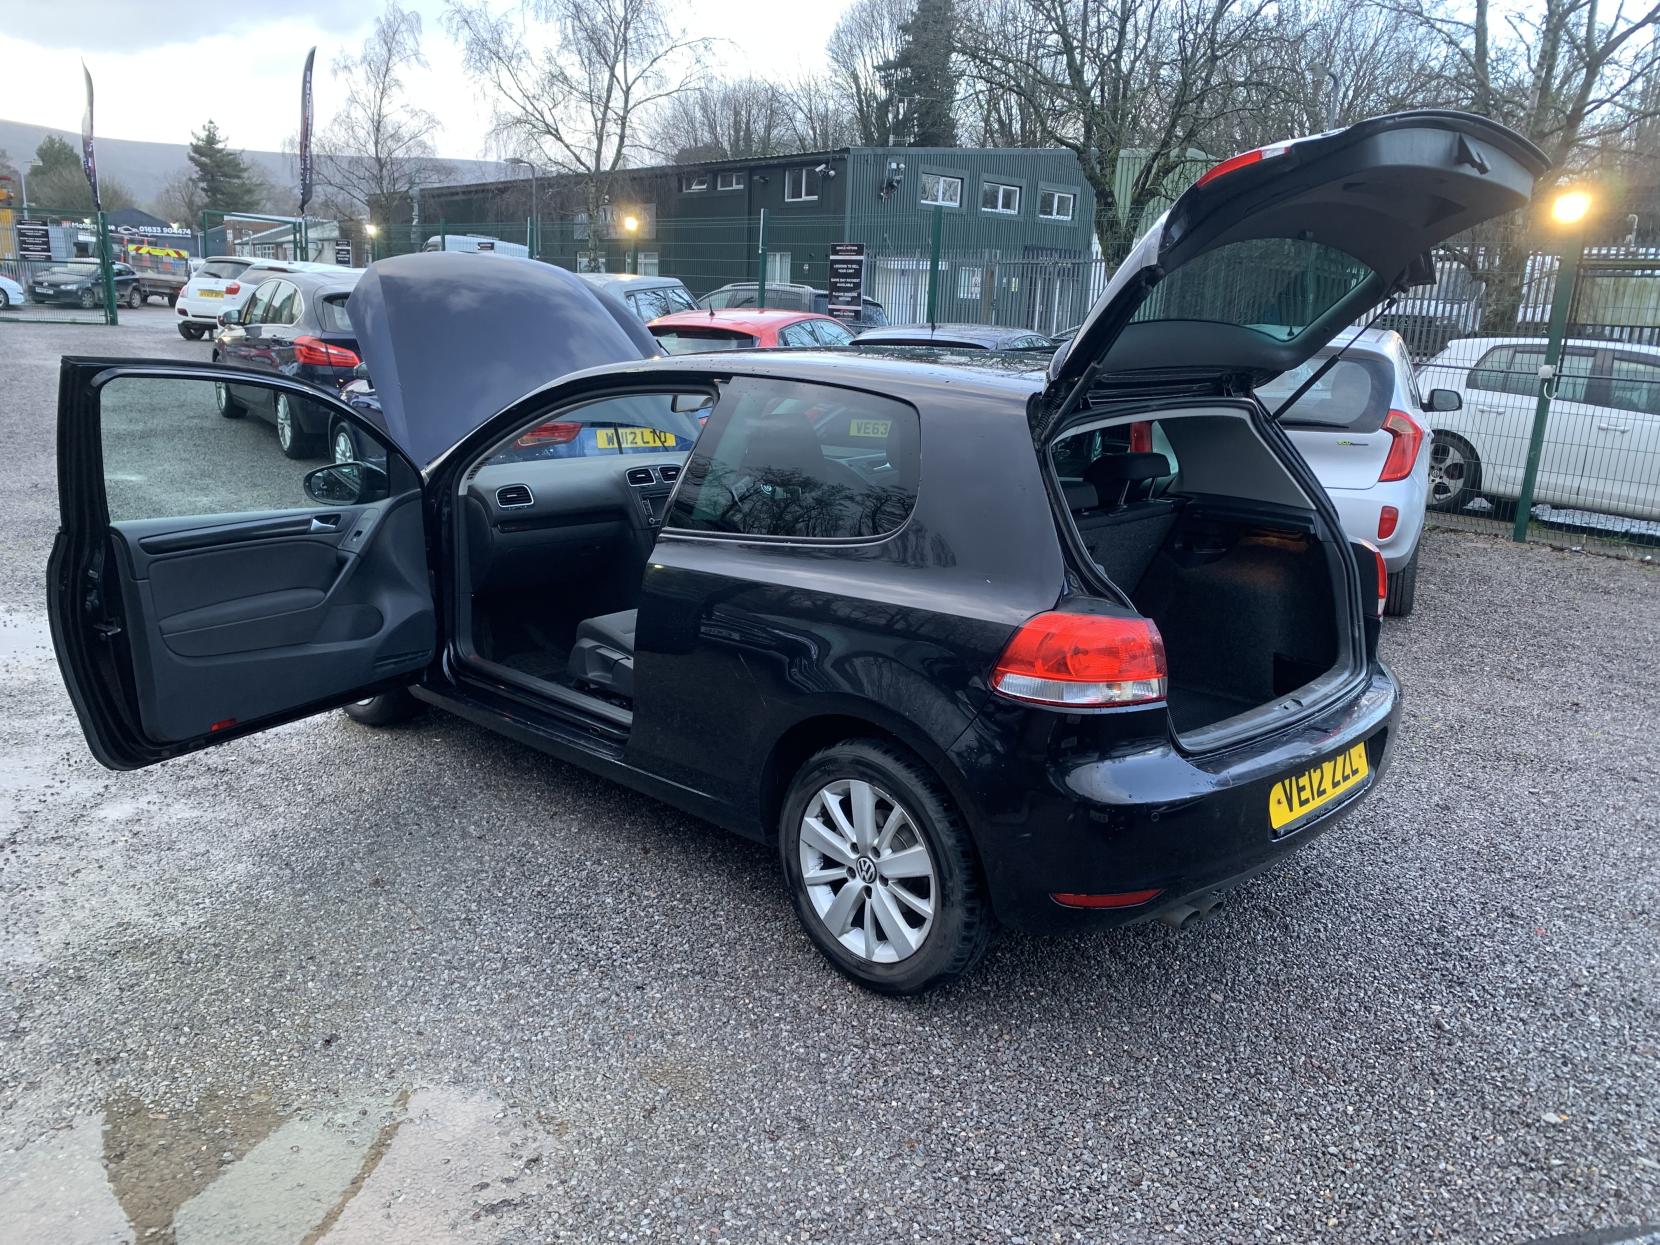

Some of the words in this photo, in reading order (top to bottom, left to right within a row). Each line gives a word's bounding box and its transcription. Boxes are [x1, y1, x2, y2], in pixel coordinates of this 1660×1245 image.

[856, 422, 888, 436] VE63
[1281, 768, 1327, 812] VE12
[1325, 750, 1359, 789] ZZL
